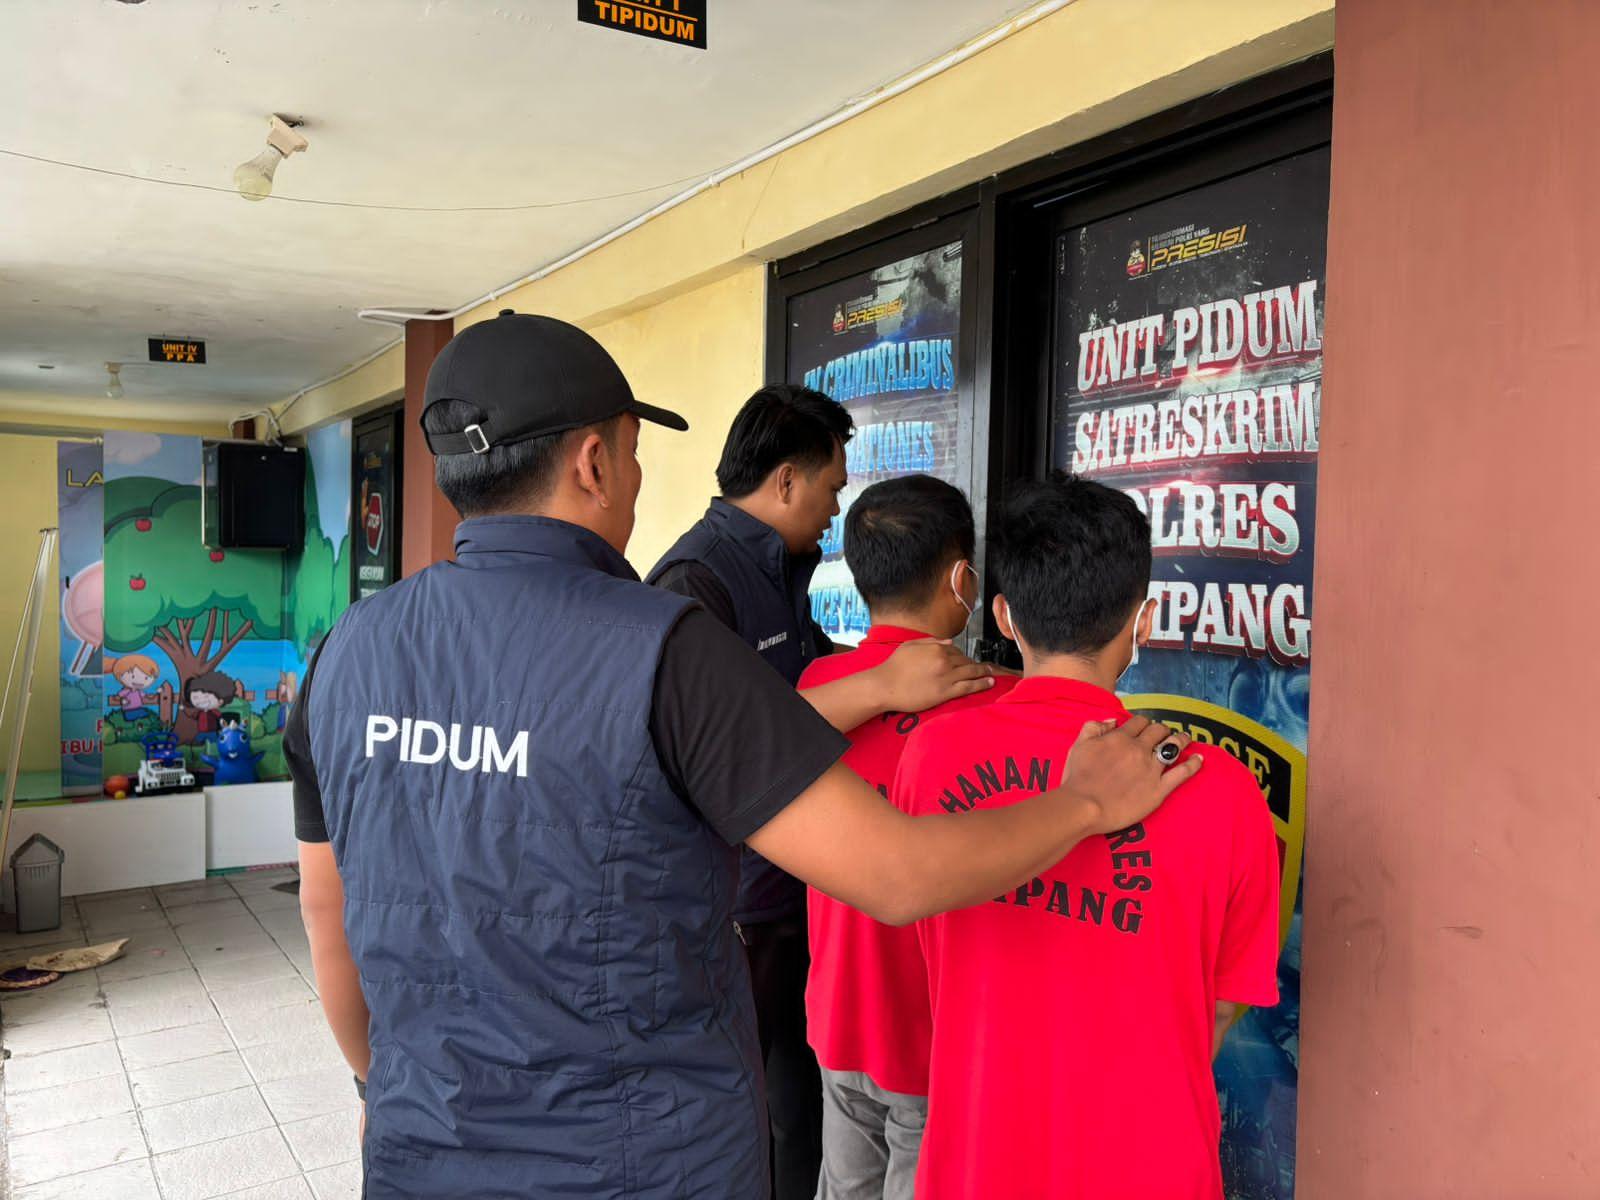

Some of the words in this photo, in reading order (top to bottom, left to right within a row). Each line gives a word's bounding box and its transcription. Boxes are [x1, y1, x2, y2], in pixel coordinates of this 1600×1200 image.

[594, 0, 695, 41] TIPIDUM
[1151, 223, 1248, 267] PRESISI
[162, 343, 184, 353] UNIT
[187, 344, 198, 353] IV
[1077, 313, 1165, 392] UNIT
[1172, 279, 1322, 369] PIDUM
[844, 421, 935, 474] ATIONES
[1071, 382, 1320, 474] SATRESKRIM
[1124, 480, 1301, 556] LRES
[1146, 580, 1312, 659] PANG
[366, 714, 529, 777] PIDUM
[938, 756, 1052, 815] HANAN
[1102, 821, 1153, 894] RES
[992, 876, 1144, 935] PANG
